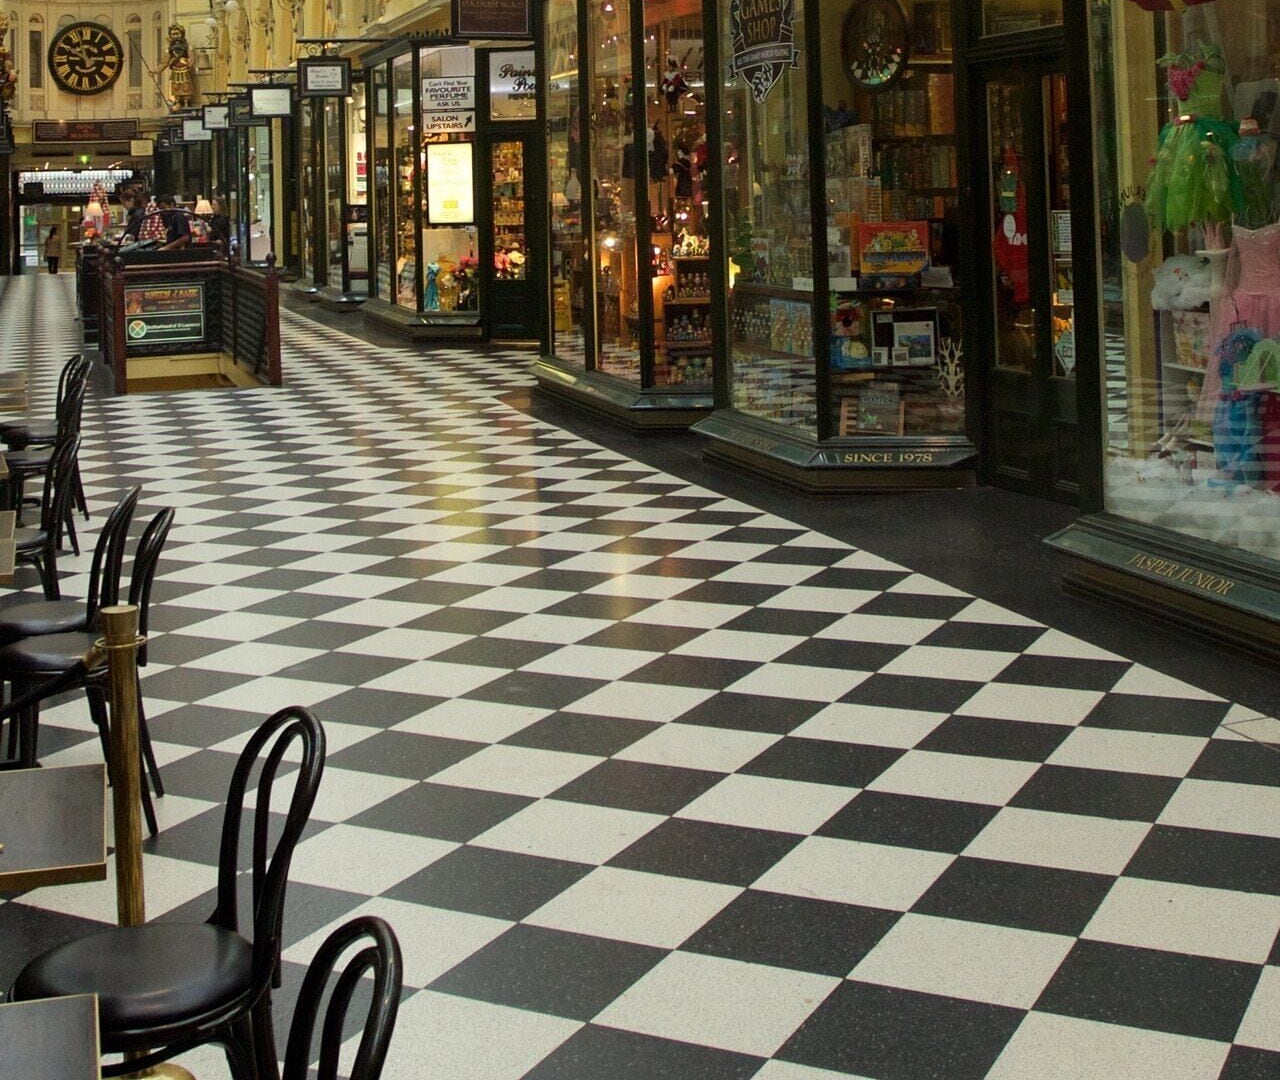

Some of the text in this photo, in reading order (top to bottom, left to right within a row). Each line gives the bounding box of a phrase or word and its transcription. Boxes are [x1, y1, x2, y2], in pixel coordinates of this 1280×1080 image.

[747, 16, 776, 42] SHOP
[844, 452, 933, 463] SINCE 1978
[1125, 553, 1235, 595] JASPER JUNIOR
